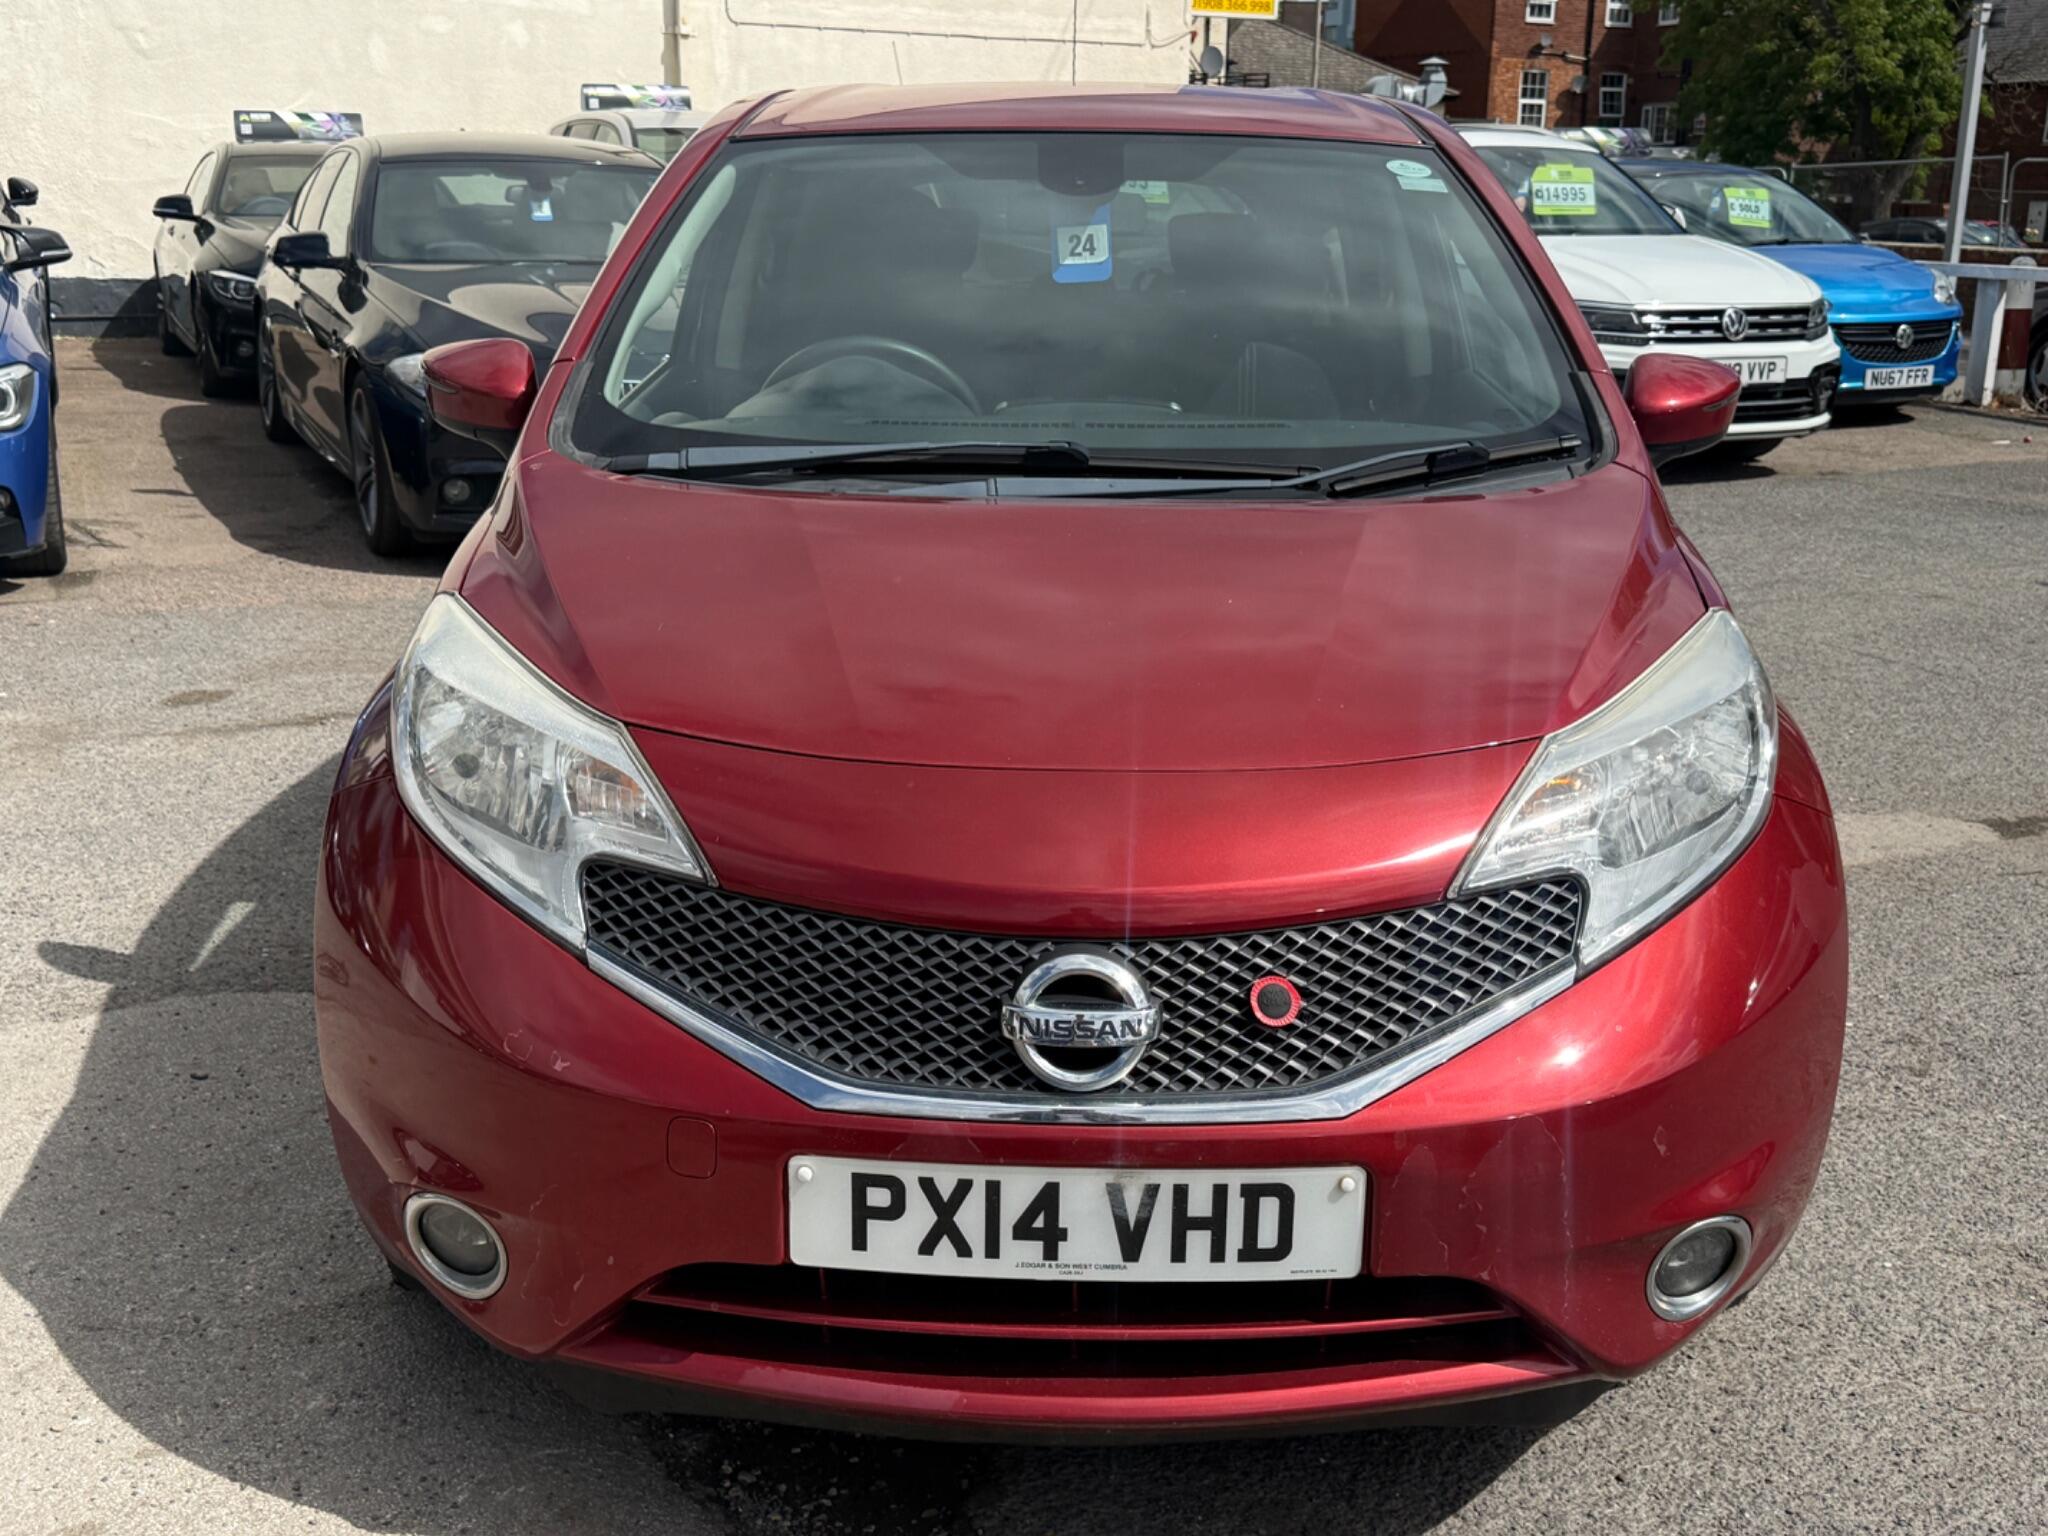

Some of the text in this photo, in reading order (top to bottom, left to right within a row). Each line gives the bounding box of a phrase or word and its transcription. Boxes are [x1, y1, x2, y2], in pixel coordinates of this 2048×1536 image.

[1068, 233, 1096, 257] 24
[1747, 361, 1776, 380] VVP
[1871, 368, 1929, 386] NU67 FFR
[1018, 1017, 1143, 1039] NISSAN
[850, 1172, 1296, 1263] PX14 VHD
